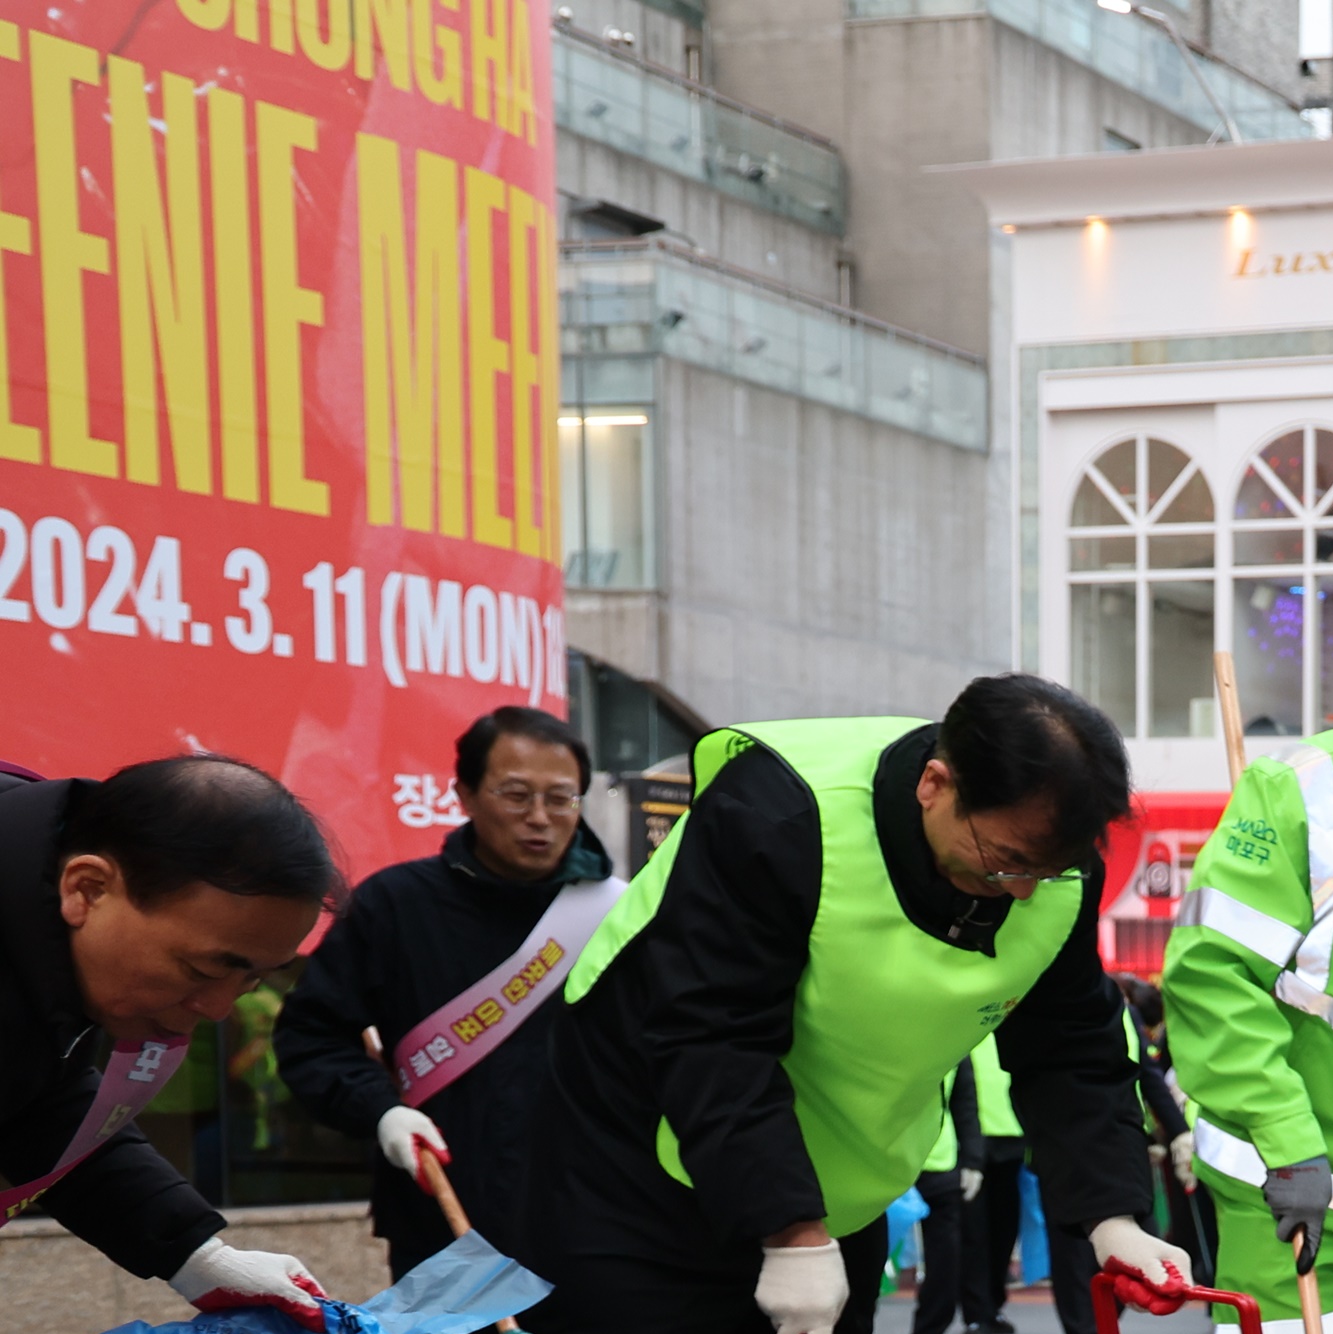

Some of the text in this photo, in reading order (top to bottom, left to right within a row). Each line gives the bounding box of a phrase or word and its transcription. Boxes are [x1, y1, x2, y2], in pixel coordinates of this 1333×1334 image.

[0, 506, 212, 646] 2024.
[223, 547, 294, 658] 3.
[302, 560, 368, 667] 11
[379, 570, 544, 707] (MON)
[1226, 835, 1271, 866] 마포구
